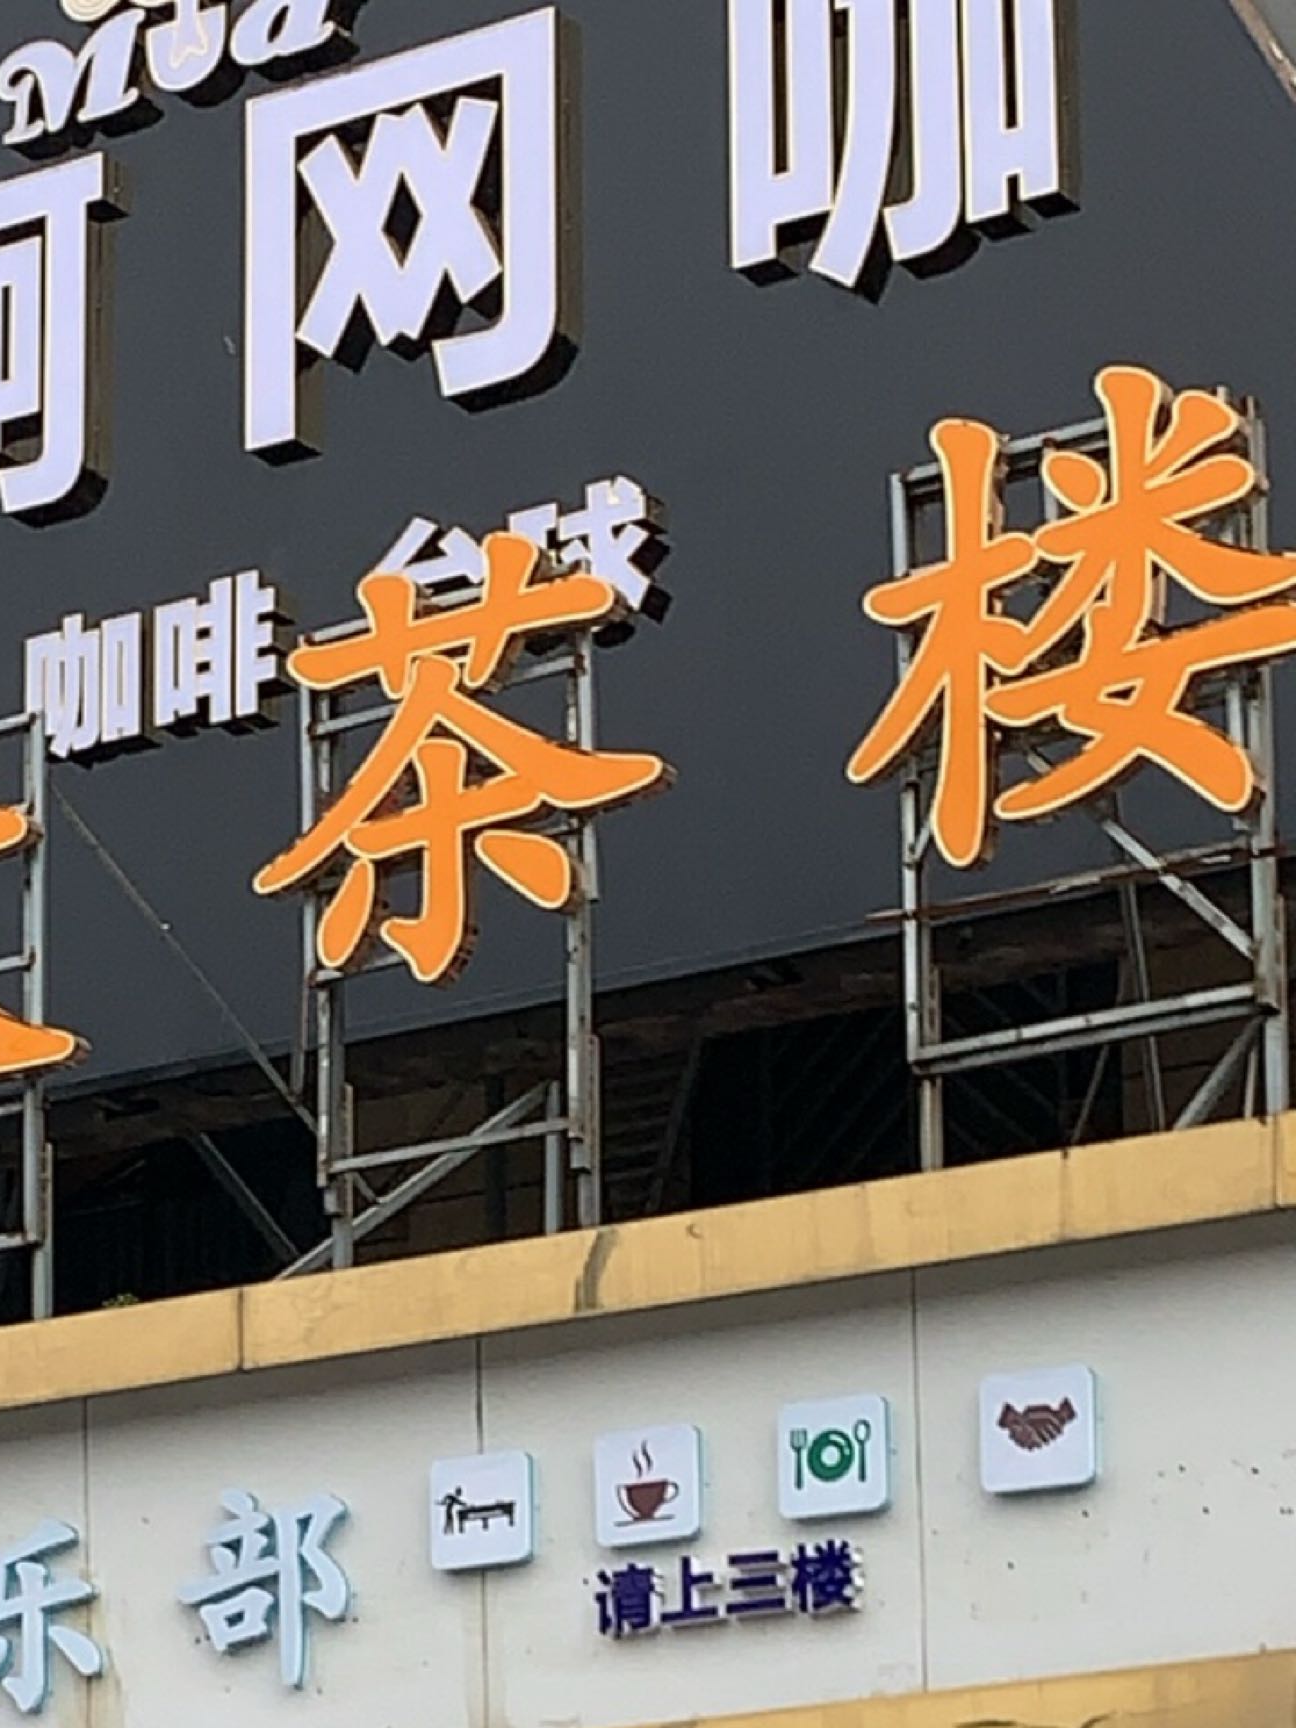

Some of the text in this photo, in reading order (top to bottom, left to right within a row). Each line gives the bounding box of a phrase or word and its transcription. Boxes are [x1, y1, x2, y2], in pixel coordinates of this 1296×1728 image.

[26, 569, 277, 758] 咖啡
[596, 1538, 862, 1639] 请上三楼
